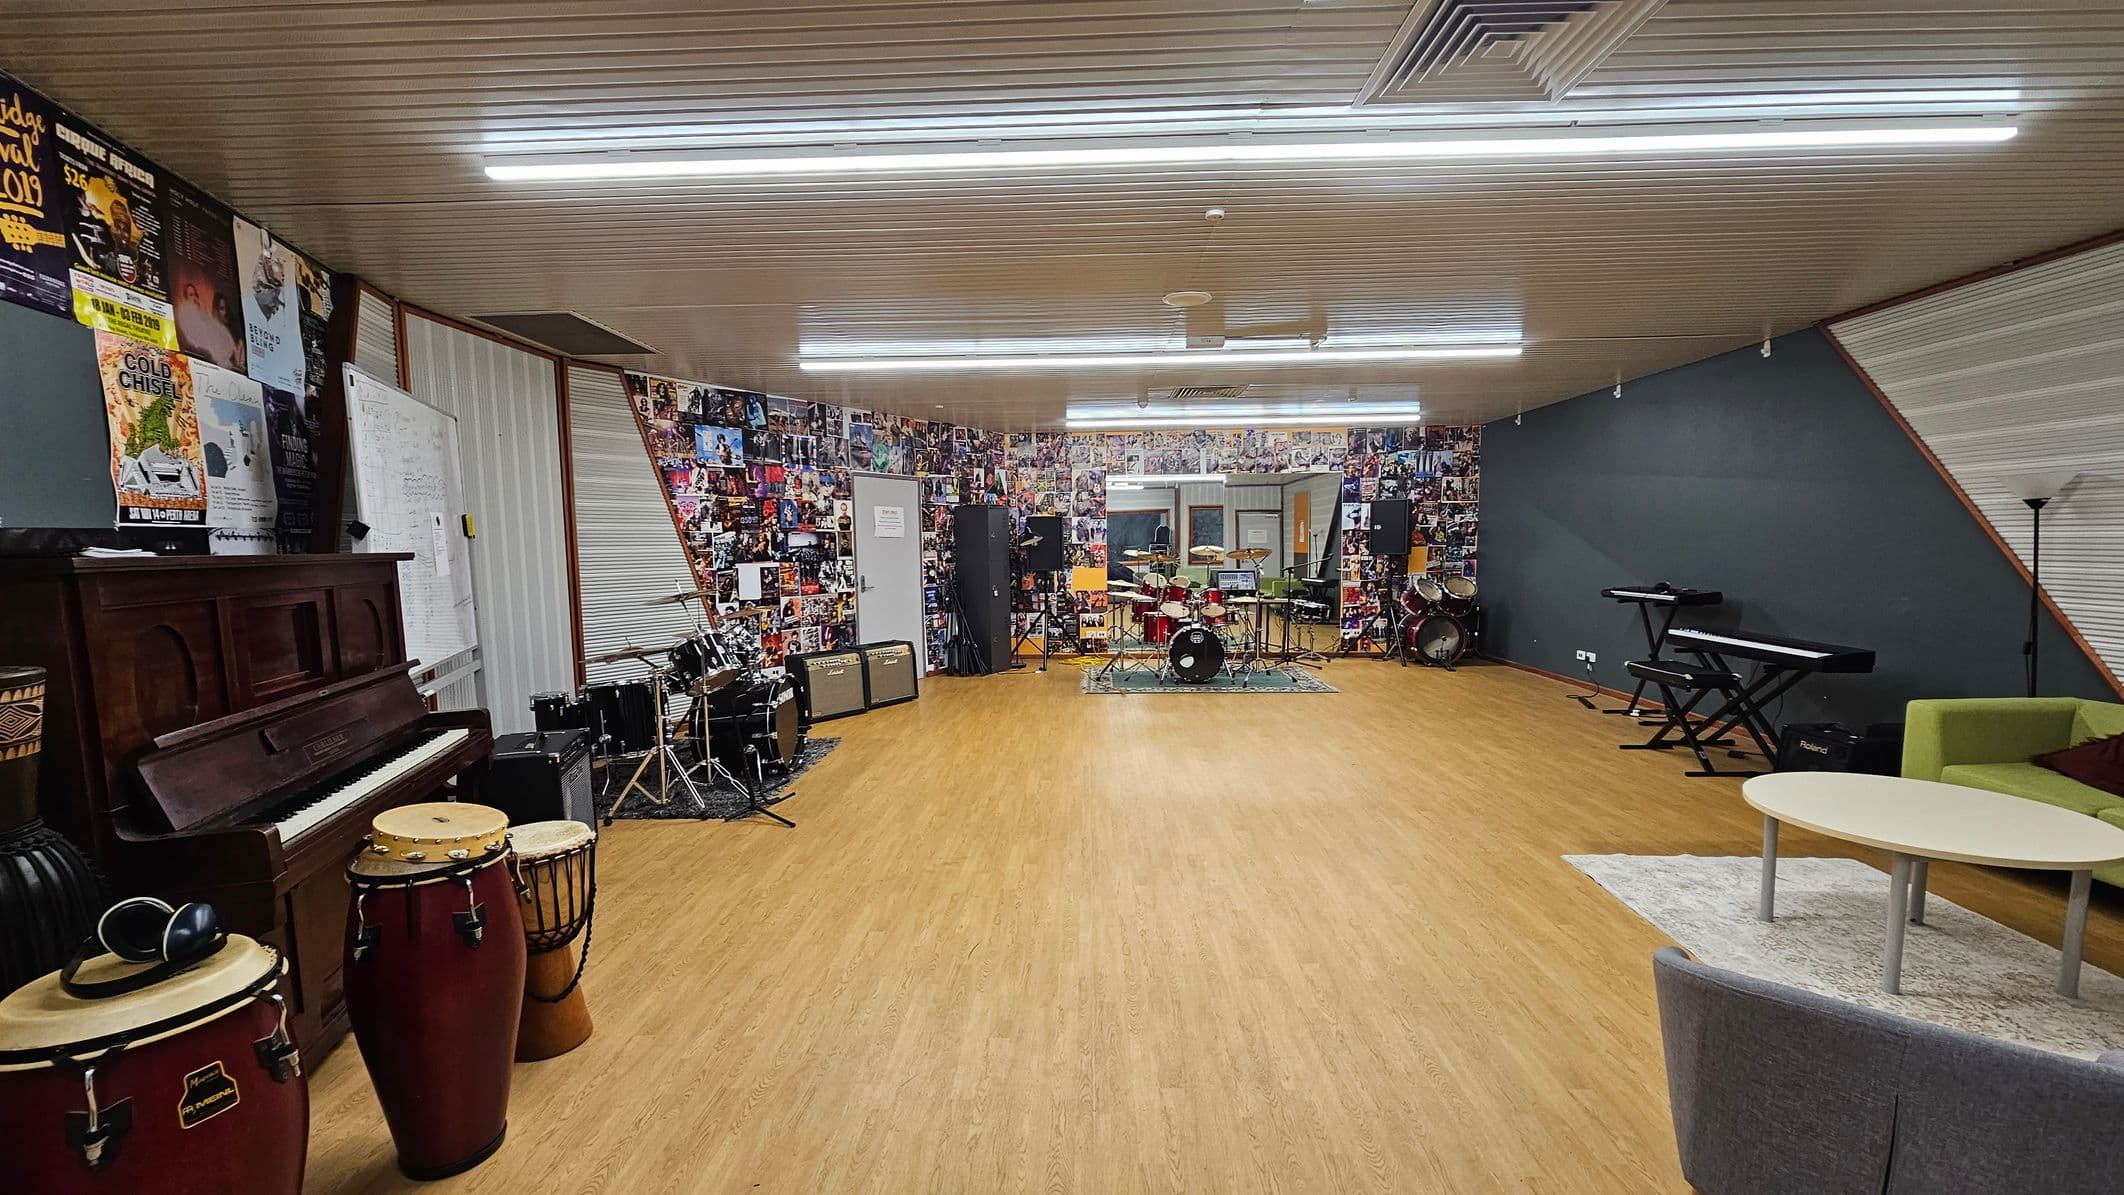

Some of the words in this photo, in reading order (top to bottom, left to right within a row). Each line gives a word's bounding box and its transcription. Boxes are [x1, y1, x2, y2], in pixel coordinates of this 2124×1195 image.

[55, 122, 107, 162] CIRQUE
[109, 152, 155, 190] AFRICA
[63, 162, 88, 192] $26
[101, 301, 116, 316] JAN
[131, 310, 144, 325] FEB
[143, 314, 161, 331] 2019
[248, 322, 281, 345] BEYOND
[249, 333, 274, 352] BLING
[124, 353, 172, 379] COLD
[118, 370, 182, 400] CHISEL
[1799, 740, 1829, 755] Roland
